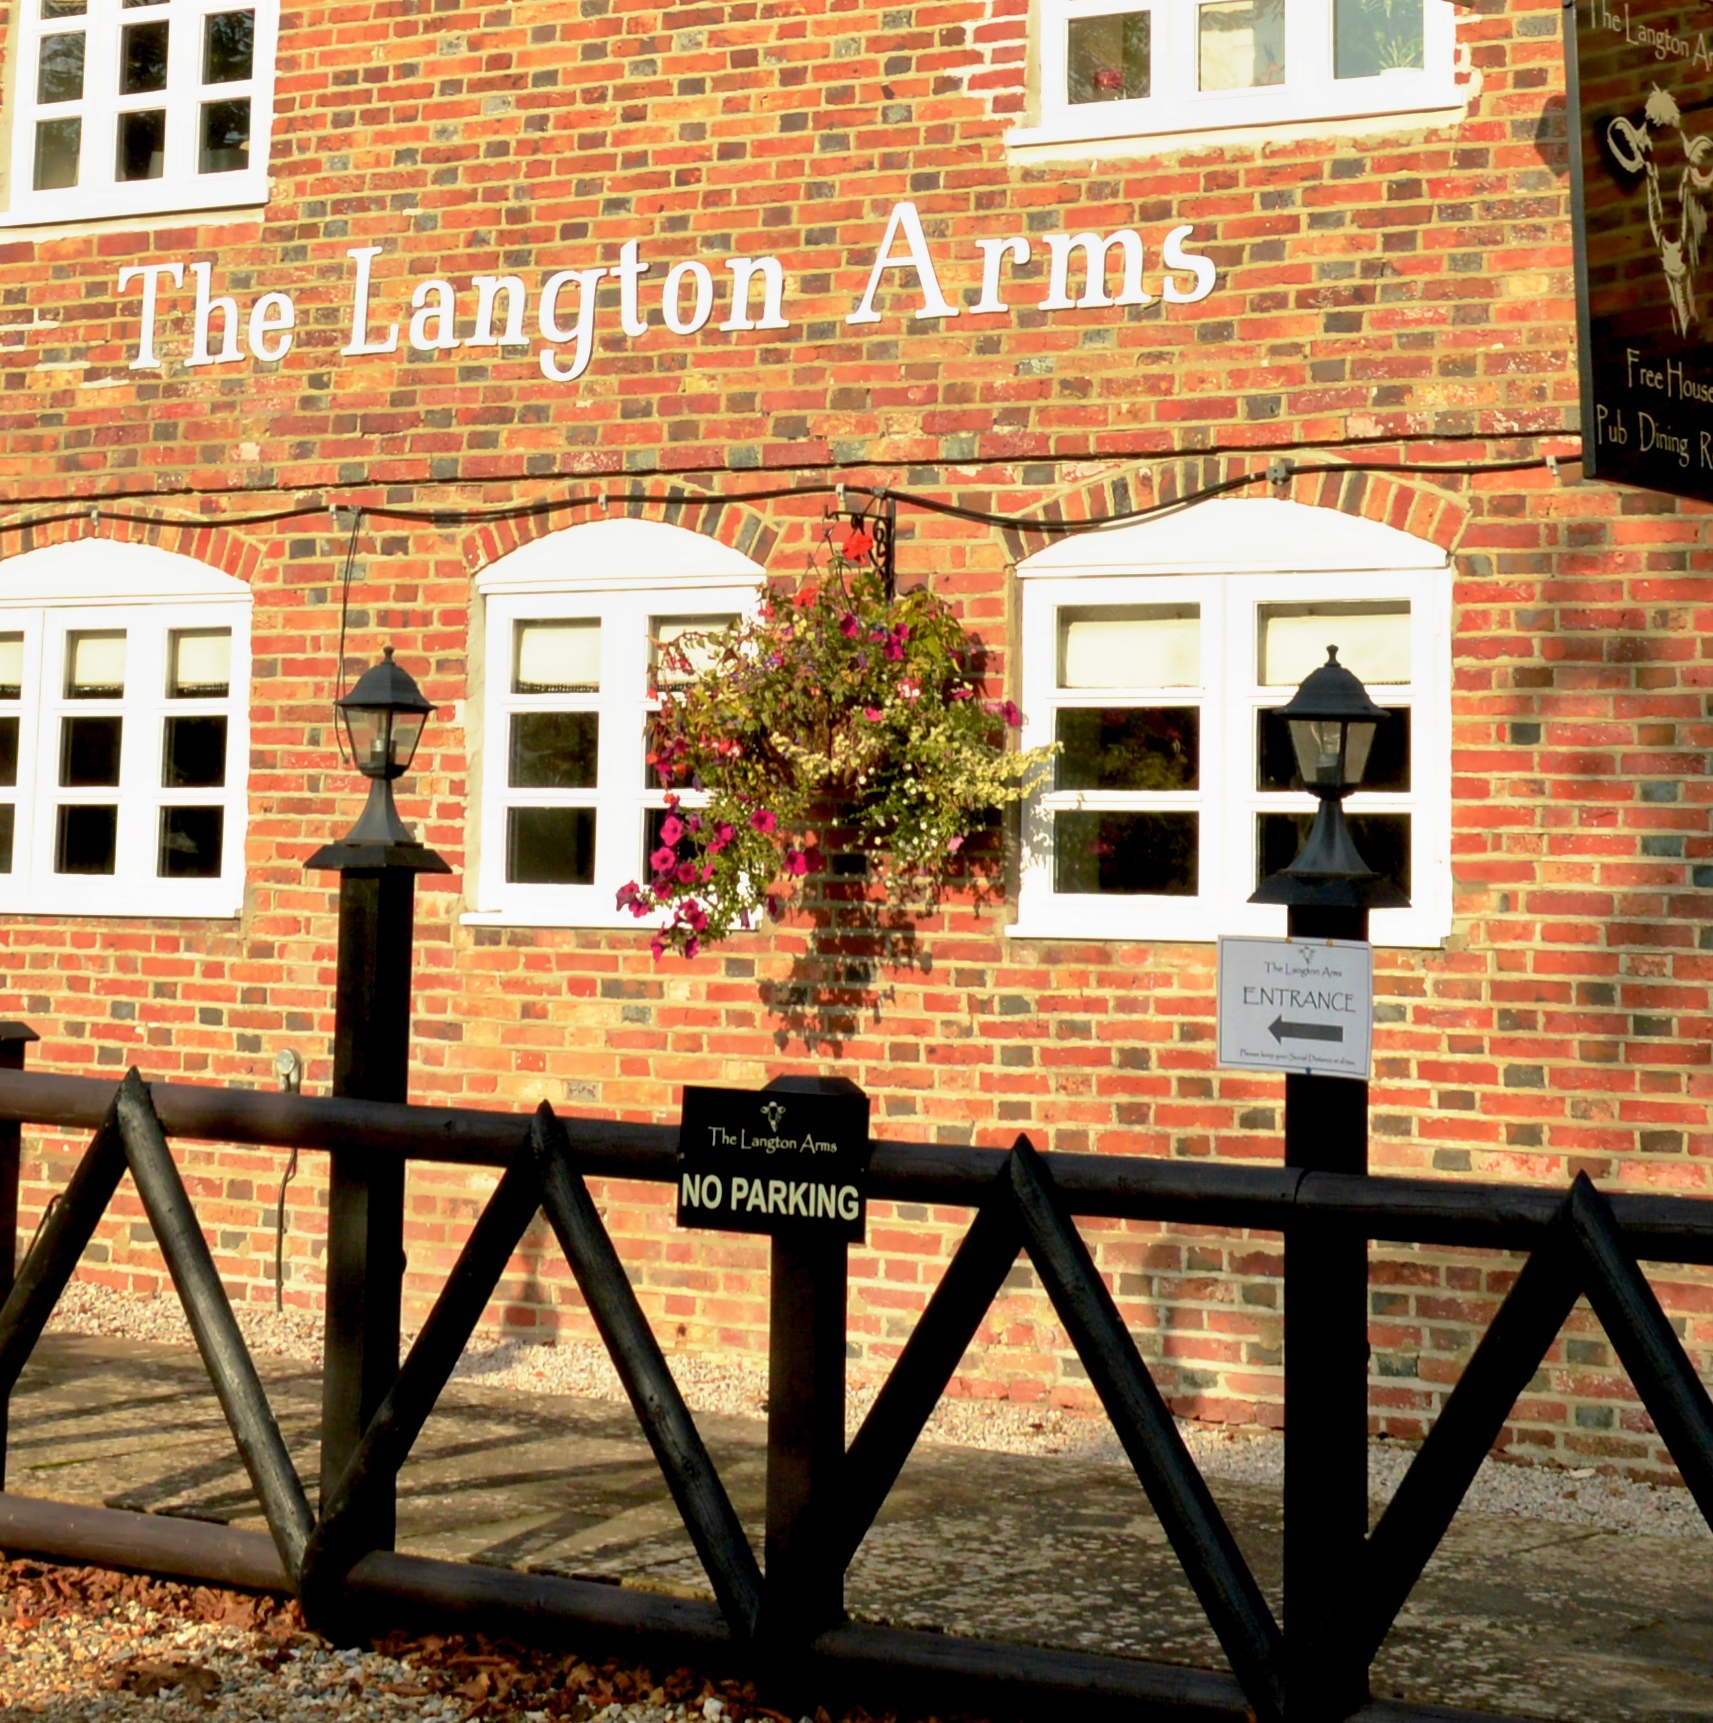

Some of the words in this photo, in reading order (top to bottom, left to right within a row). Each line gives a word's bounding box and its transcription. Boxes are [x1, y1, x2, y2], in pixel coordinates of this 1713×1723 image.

[1624, 4, 1689, 61] Langton
[117, 261, 294, 372] The
[341, 239, 789, 381] Langton
[846, 201, 1217, 325] Arms
[1627, 349, 1663, 391] Free
[1596, 404, 1627, 446] Pub
[1638, 411, 1689, 468] Dining
[1264, 961, 1283, 973] The
[1285, 962, 1320, 978] Langton
[1321, 966, 1342, 978] Arms
[1243, 986, 1356, 1013] ENTRANCE
[708, 1126, 737, 1146] The
[741, 1128, 797, 1154] Langton
[800, 1133, 837, 1154] Arms
[682, 1173, 723, 1209] NO
[731, 1177, 859, 1221] PARKING
